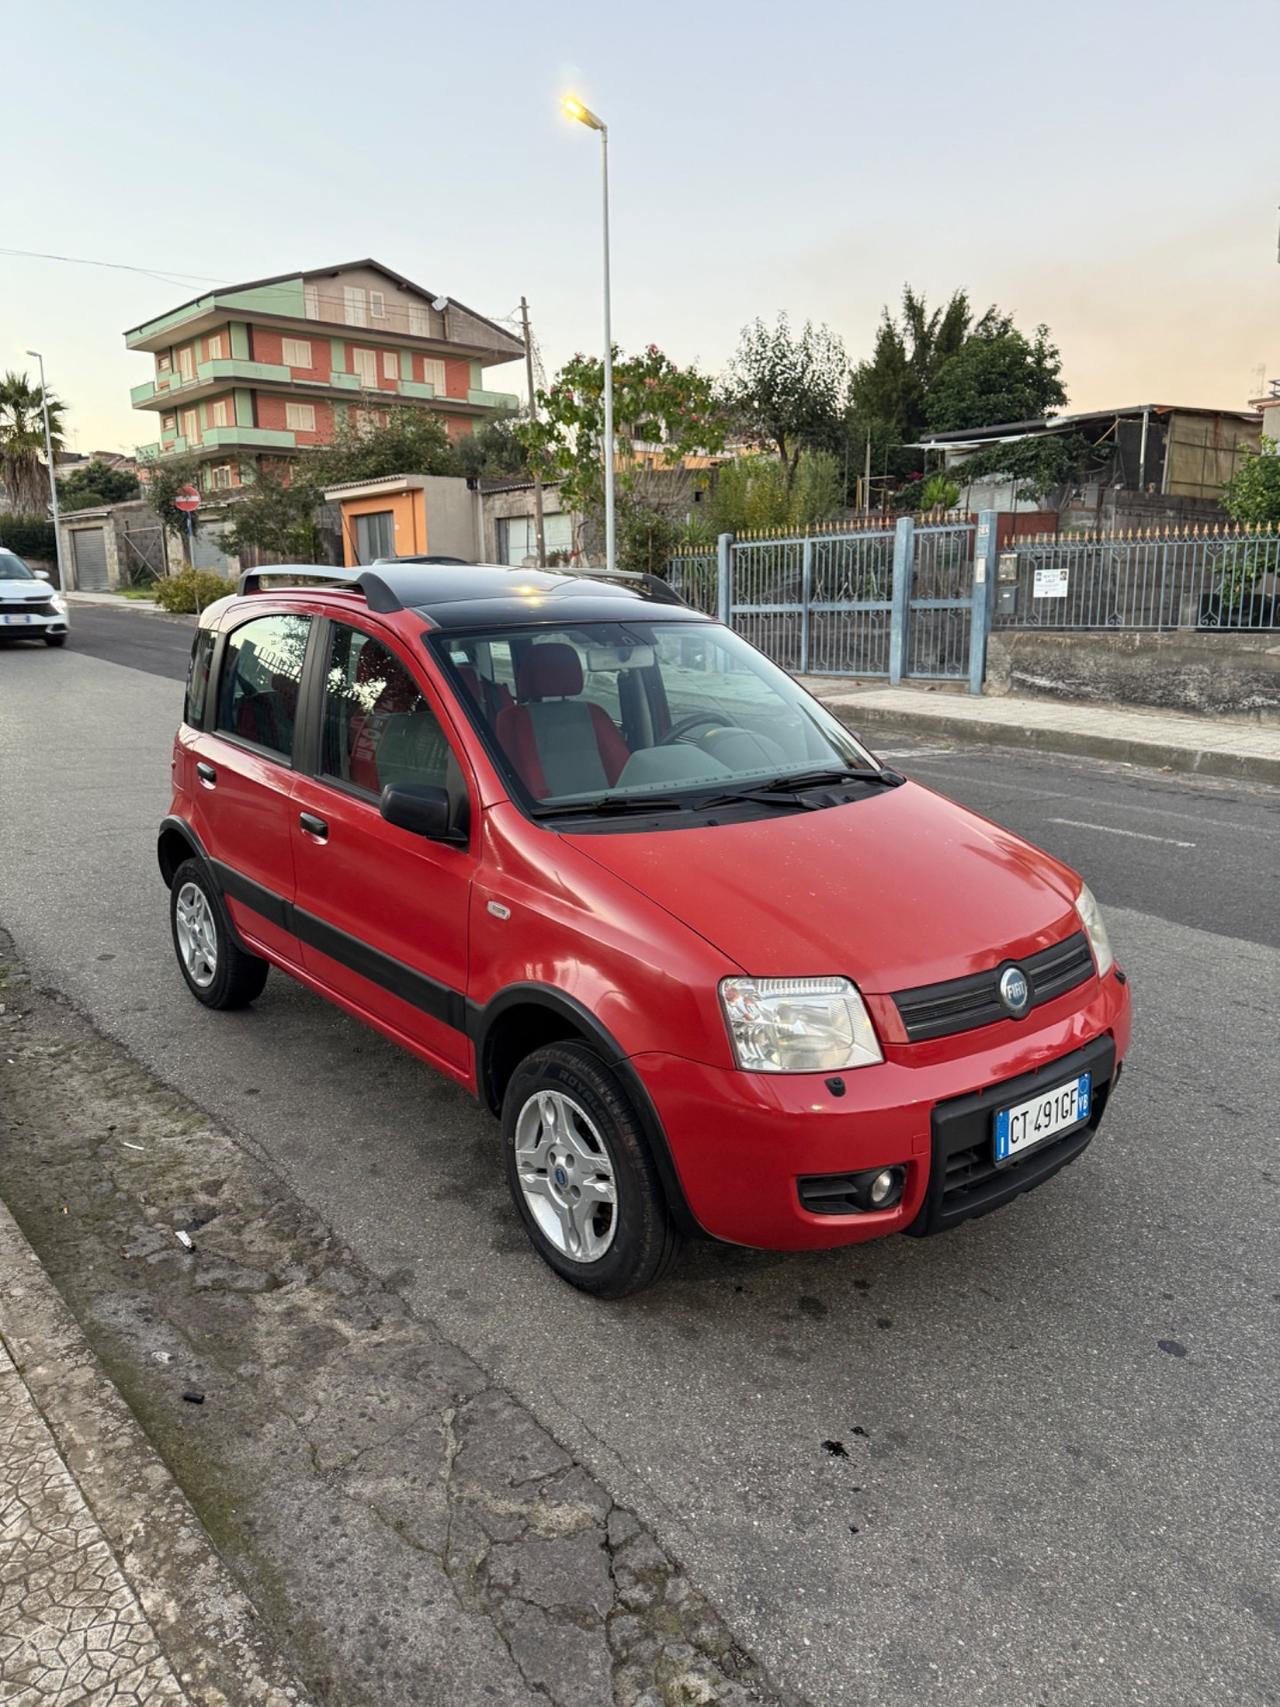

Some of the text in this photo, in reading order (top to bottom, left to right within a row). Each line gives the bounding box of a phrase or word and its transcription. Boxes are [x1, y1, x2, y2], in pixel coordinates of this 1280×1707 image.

[1007, 981, 1025, 999] FIAT
[1010, 1110, 1029, 1144] CT
[1034, 1087, 1078, 1132] 491GF
